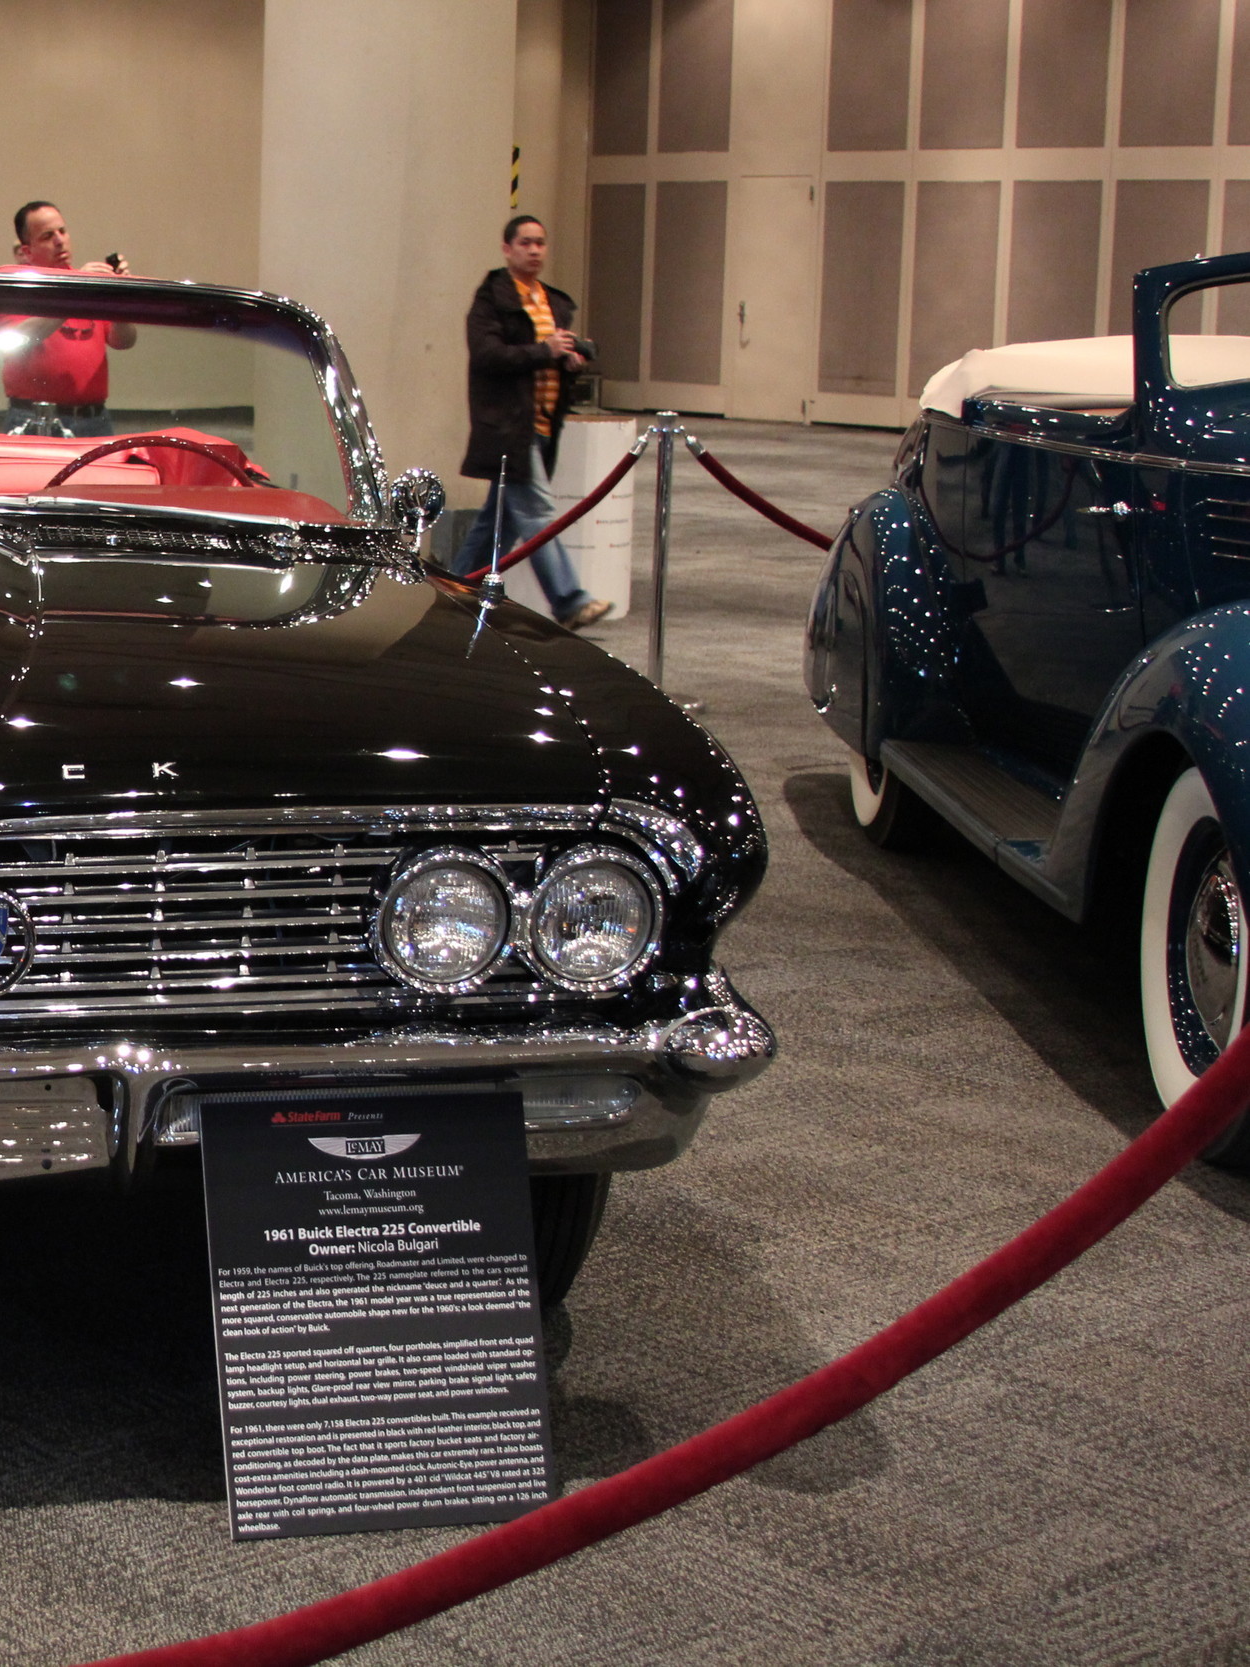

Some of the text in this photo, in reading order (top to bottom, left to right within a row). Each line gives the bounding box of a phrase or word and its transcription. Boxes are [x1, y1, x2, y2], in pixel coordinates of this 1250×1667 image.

[348, 1112, 383, 1121] Presents
[275, 1169, 351, 1184] AMERICA'S
[358, 1168, 387, 1180] CAR
[324, 1188, 416, 1201] Tacoma, Washington
[319, 1203, 424, 1216] www.lemaymuseum.org
[264, 1219, 481, 1241] 1961 Buick Electra 225 Convertible
[309, 1238, 439, 1255] Owner: Nicola Bulgari
[218, 1267, 230, 1275] For
[303, 1263, 328, 1271] Buick's
[376, 1258, 419, 1267] Roadmaster
[486, 1253, 517, 1264] changed
[219, 1279, 244, 1287] Electra
[264, 1277, 289, 1285] Electra
[388, 1270, 428, 1281] nameplate
[430, 1268, 458, 1277] referred
[503, 1265, 527, 1273] overall
[219, 1282, 421, 1302] length 225 inches generated nickname
[239, 1301, 280, 1313] generation
[351, 1297, 367, 1305] 1961
[370, 1296, 393, 1304] model
[453, 1290, 506, 1301] representation
[276, 1311, 322, 1321] conservative
[324, 1309, 366, 1318] automobile
[368, 1308, 390, 1318] shape
[485, 1301, 515, 1310] deemed
[222, 1328, 243, 1336] clean
[240, 1351, 265, 1360] Electra
[267, 1350, 281, 1358] 225
[282, 1349, 311, 1359] sported
[312, 1347, 342, 1358] squared
[442, 1339, 478, 1350] simplified
[479, 1338, 497, 1346] front
[246, 1362, 282, 1374] headlight
[323, 1358, 361, 1367] horizontal
[444, 1352, 469, 1360] loaded
[489, 1349, 520, 1357] standard
[249, 1374, 284, 1386] including
[287, 1375, 311, 1384] power
[348, 1371, 371, 1380] power
[403, 1365, 441, 1377] two-speed
[444, 1363, 483, 1372] windshield
[486, 1361, 507, 1372] wiper
[509, 1360, 535, 1368] washer
[257, 1387, 285, 1398] backup
[311, 1383, 353, 1394] Glare-proof
[418, 1377, 446, 1388] parking
[448, 1376, 469, 1384] brake
[471, 1374, 493, 1385] signal
[515, 1372, 536, 1382] safety
[255, 1399, 287, 1410] courtesy
[360, 1392, 392, 1404] two-way
[393, 1393, 416, 1402] power
[450, 1389, 473, 1398] power
[265, 1423, 285, 1432] there
[345, 1418, 370, 1427] Electra
[371, 1417, 385, 1425] 225
[386, 1414, 431, 1424] convertibles
[451, 1412, 465, 1420] This
[467, 1410, 497, 1421] example
[499, 1408, 529, 1417] received
[231, 1436, 274, 1448] exceptional
[275, 1434, 315, 1443] restoration
[339, 1430, 376, 1441] presented
[386, 1428, 405, 1436] black
[437, 1424, 462, 1433] leather
[492, 1421, 511, 1430] black
[247, 1432, 525, 1457] convertible sports factory bucket seats factory
[293, 1457, 325, 1467] decoded
[390, 1452, 414, 1460] makes
[442, 1448, 478, 1459] extremely
[519, 1443, 543, 1452] boasts
[234, 1473, 271, 1483] cost-extra
[272, 1471, 308, 1480] amenities
[309, 1468, 344, 1480] including
[350, 1464, 404, 1475] dash-mounted
[474, 1460, 497, 1469] power
[235, 1485, 276, 1495] Wonderbar
[296, 1482, 322, 1491] control
[361, 1477, 394, 1489] powered
[413, 1475, 426, 1483] 401
[501, 1469, 520, 1477] rated
[532, 1467, 545, 1475] 325
[283, 1495, 318, 1506] Dynaflow
[320, 1492, 357, 1502] automatic
[408, 1485, 455, 1498] independent
[456, 1484, 474, 1492] front
[476, 1481, 516, 1493] suspension
[354, 1502, 394, 1512] four-wheel
[396, 1502, 419, 1511] power
[471, 1495, 494, 1506] sitting
[516, 1492, 529, 1500] 126
